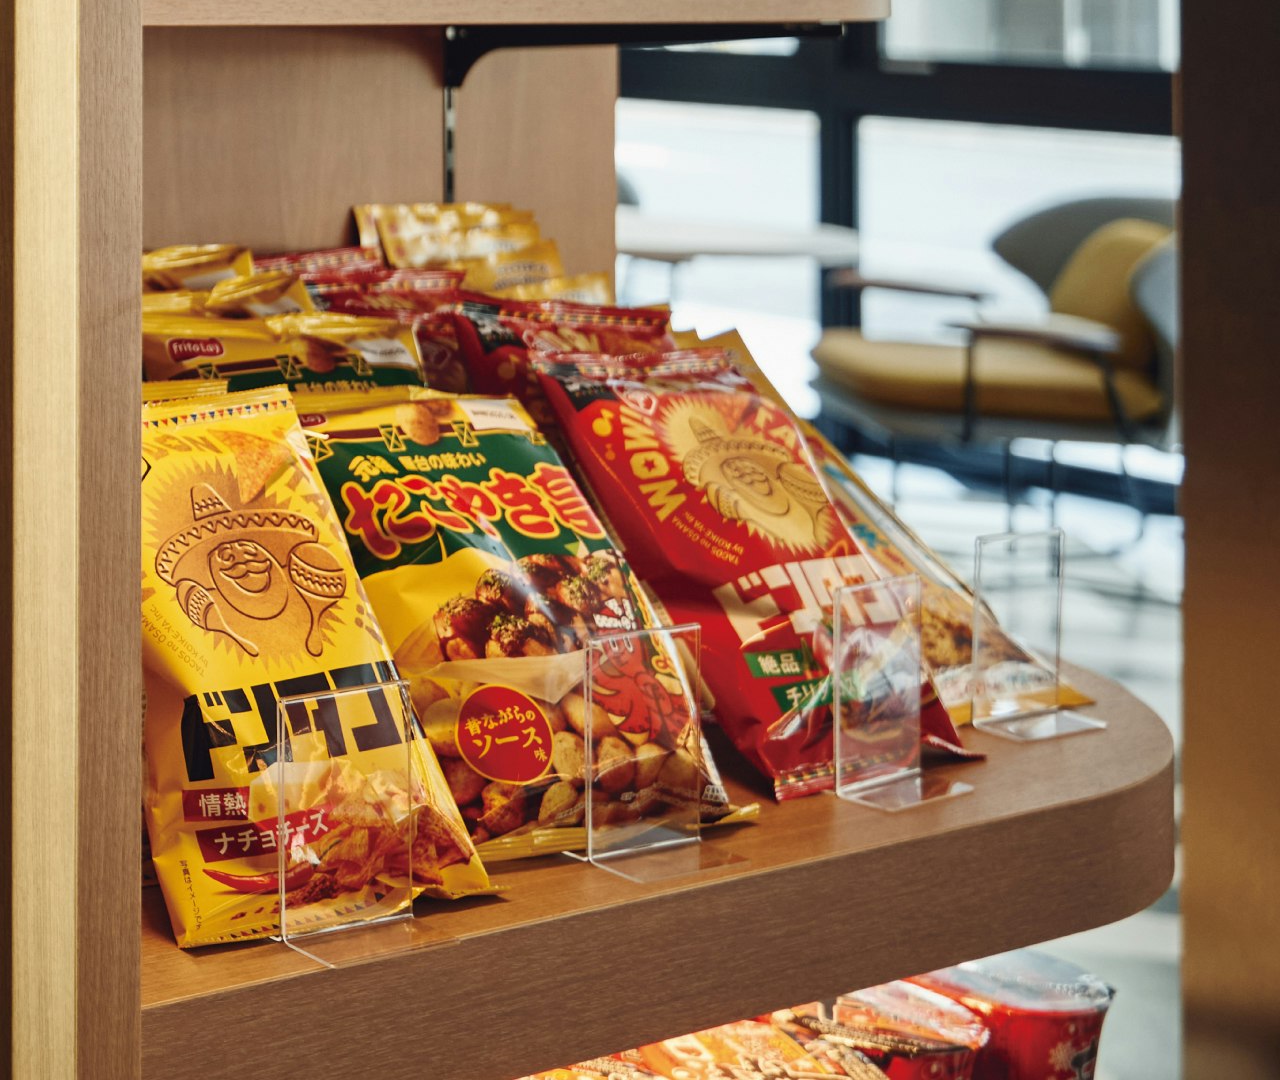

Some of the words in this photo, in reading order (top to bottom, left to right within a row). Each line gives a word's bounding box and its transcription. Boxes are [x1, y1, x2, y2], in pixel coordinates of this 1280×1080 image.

[757, 653, 800, 675] 絶品
[465, 708, 536, 736] 昔ながらの
[472, 726, 543, 759] ソース
[534, 747, 549, 763] 味
[199, 792, 247, 817] 情熱
[214, 808, 329, 856] ナチョチーズ
